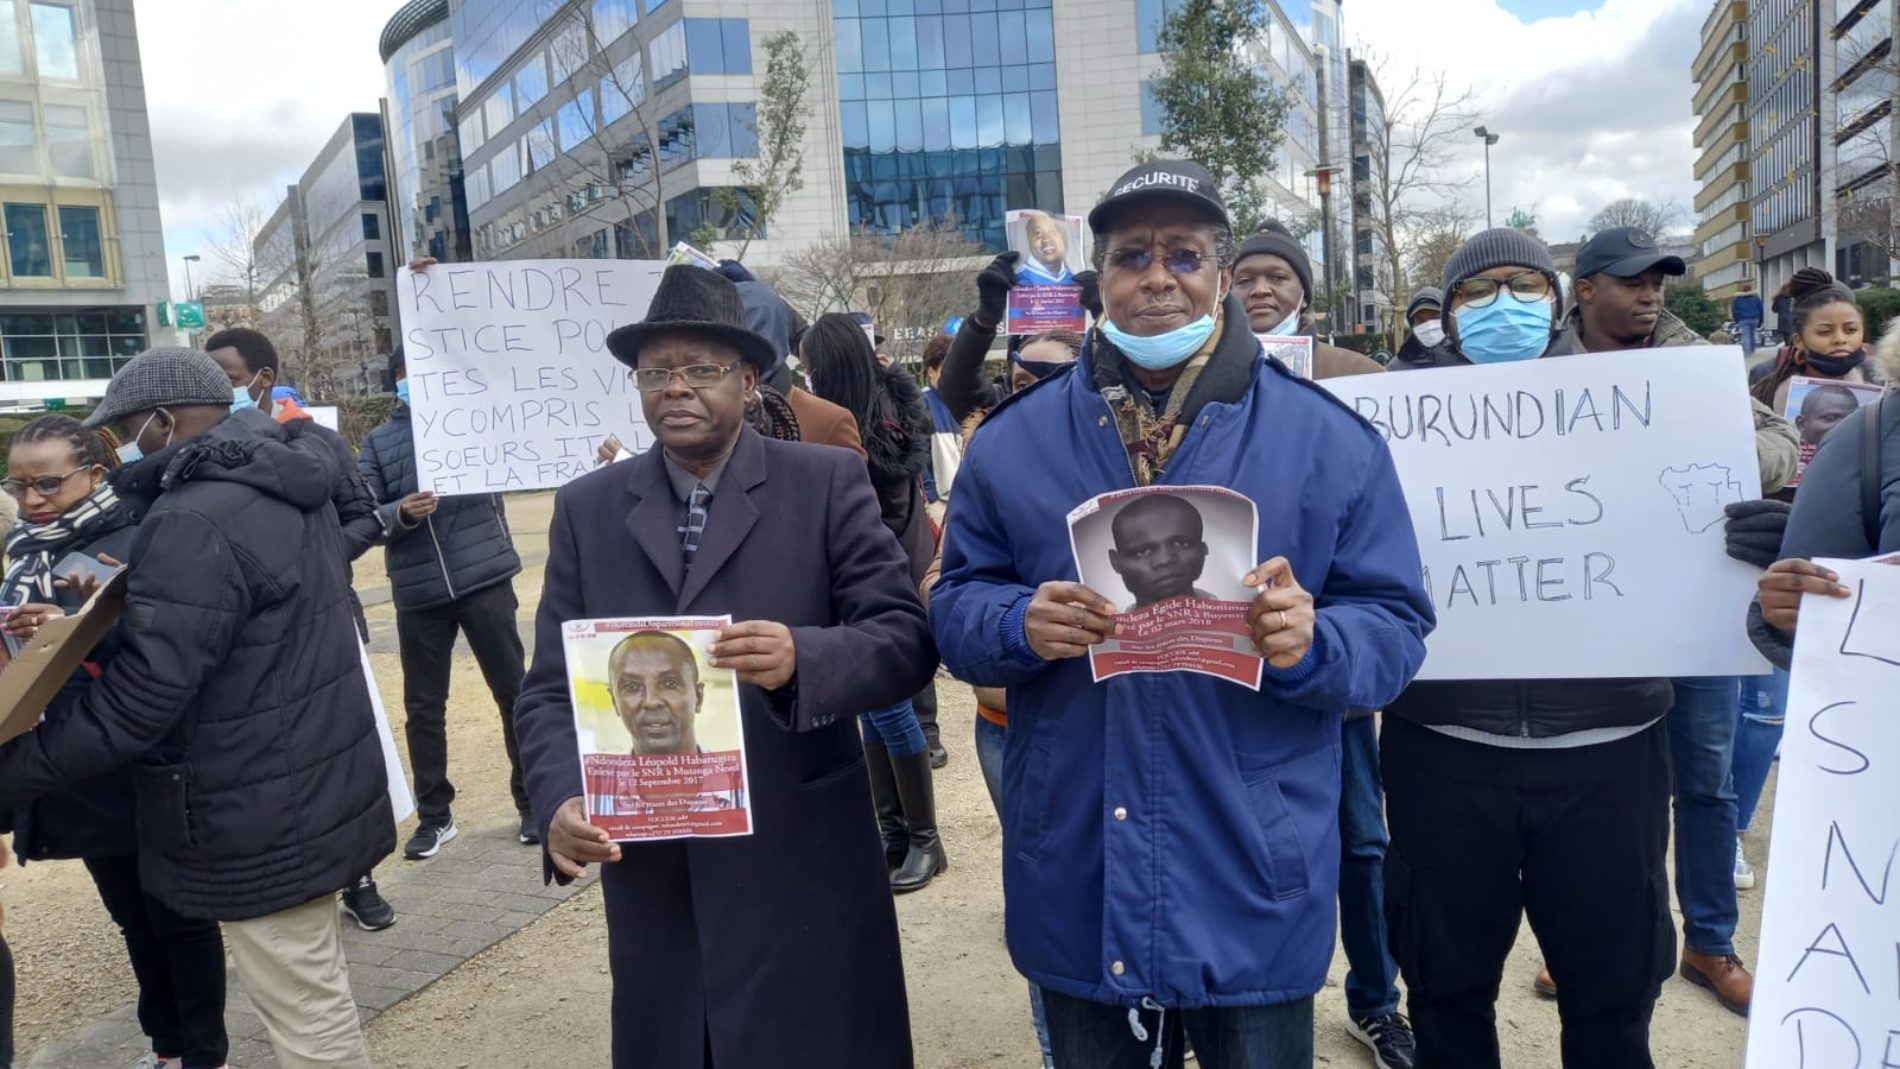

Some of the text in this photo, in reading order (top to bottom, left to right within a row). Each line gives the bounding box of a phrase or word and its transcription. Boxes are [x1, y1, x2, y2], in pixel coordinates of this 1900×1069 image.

[410, 268, 627, 312] RENDRE
[408, 323, 533, 361] STICE
[413, 367, 488, 402] TES
[511, 366, 579, 392] LES
[419, 398, 601, 438] YCOMPRIS
[1355, 379, 1652, 447] BURUNDIAN
[422, 441, 541, 473] SOEURS
[432, 473, 467, 496] ET
[484, 466, 524, 488] LA
[1436, 474, 1604, 542] LIVES
[1165, 619, 1186, 628] mars
[1188, 617, 1212, 626] 2018
[1167, 608, 1192, 619] SNR
[639, 754, 678, 770] Léopold
[641, 768, 664, 777] SNR
[684, 775, 704, 785] 2017
